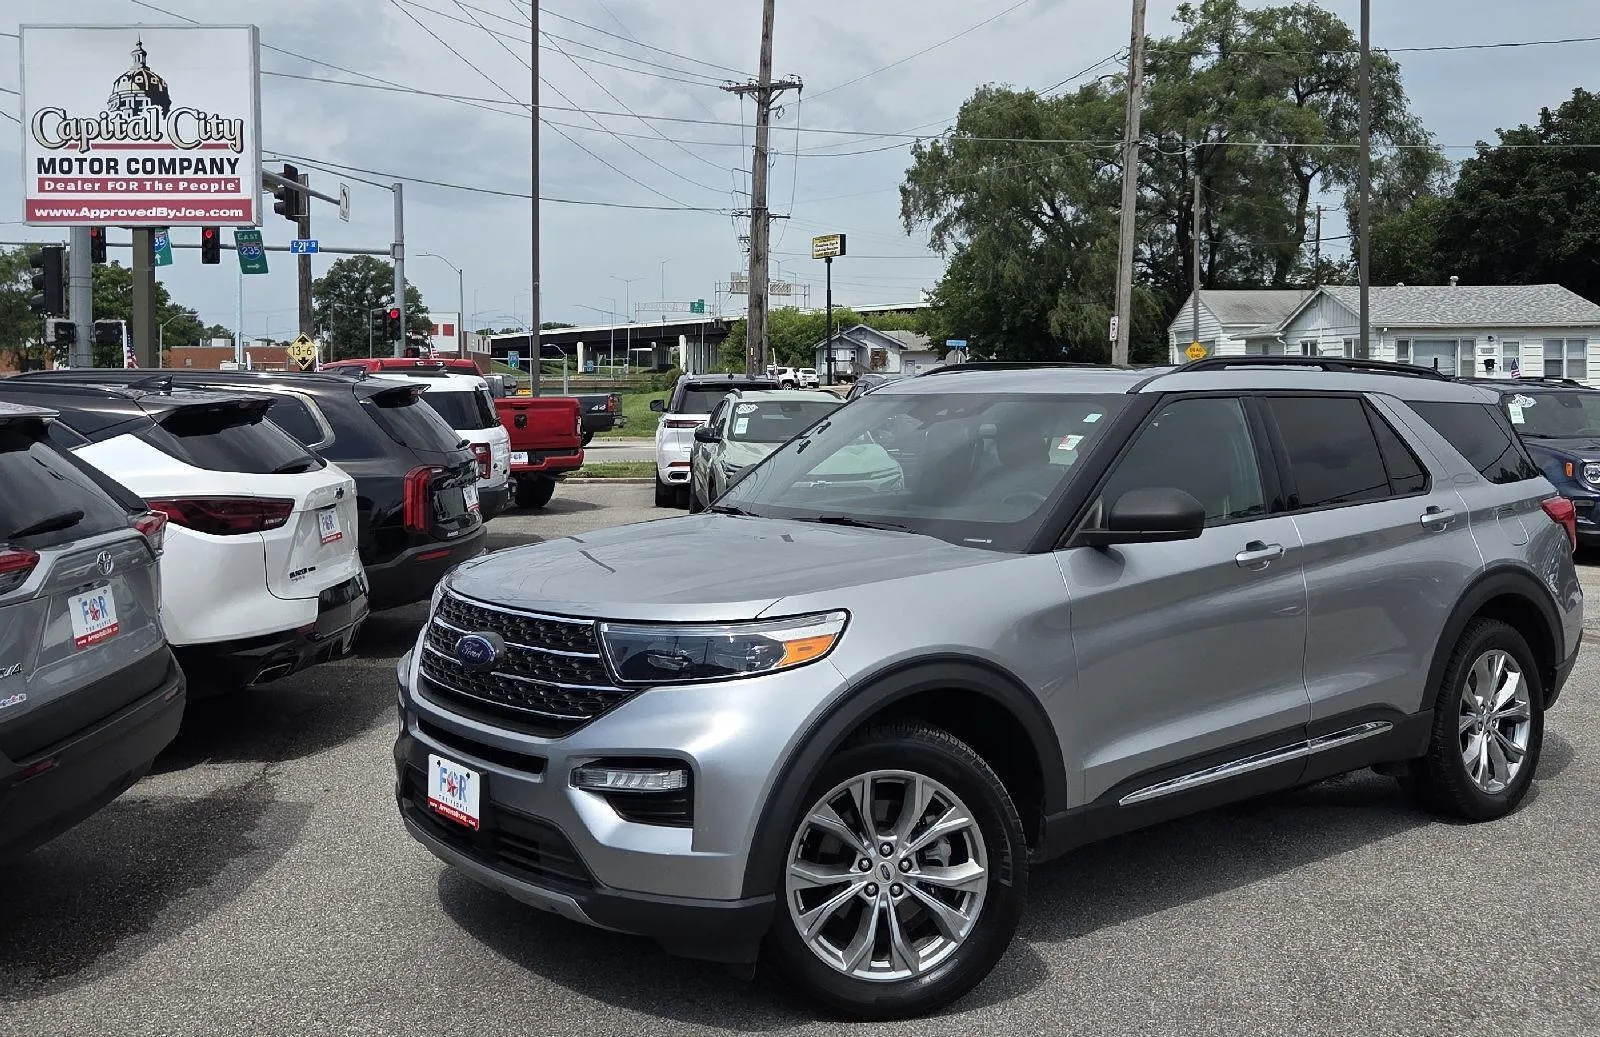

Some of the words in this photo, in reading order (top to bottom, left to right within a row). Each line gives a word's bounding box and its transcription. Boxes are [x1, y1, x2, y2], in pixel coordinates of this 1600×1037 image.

[31, 107, 163, 153] Capital
[167, 107, 244, 153] City
[37, 158, 119, 175] MOTOR
[126, 158, 240, 175] COMPANY
[44, 181, 100, 191] Dealer
[107, 181, 138, 191] FOR
[144, 181, 173, 191] The
[34, 207, 244, 218] www.ApprovedByJoe.com
[241, 246, 260, 255] 235
[82, 595, 108, 625] FOR
[439, 766, 468, 802] FOR
